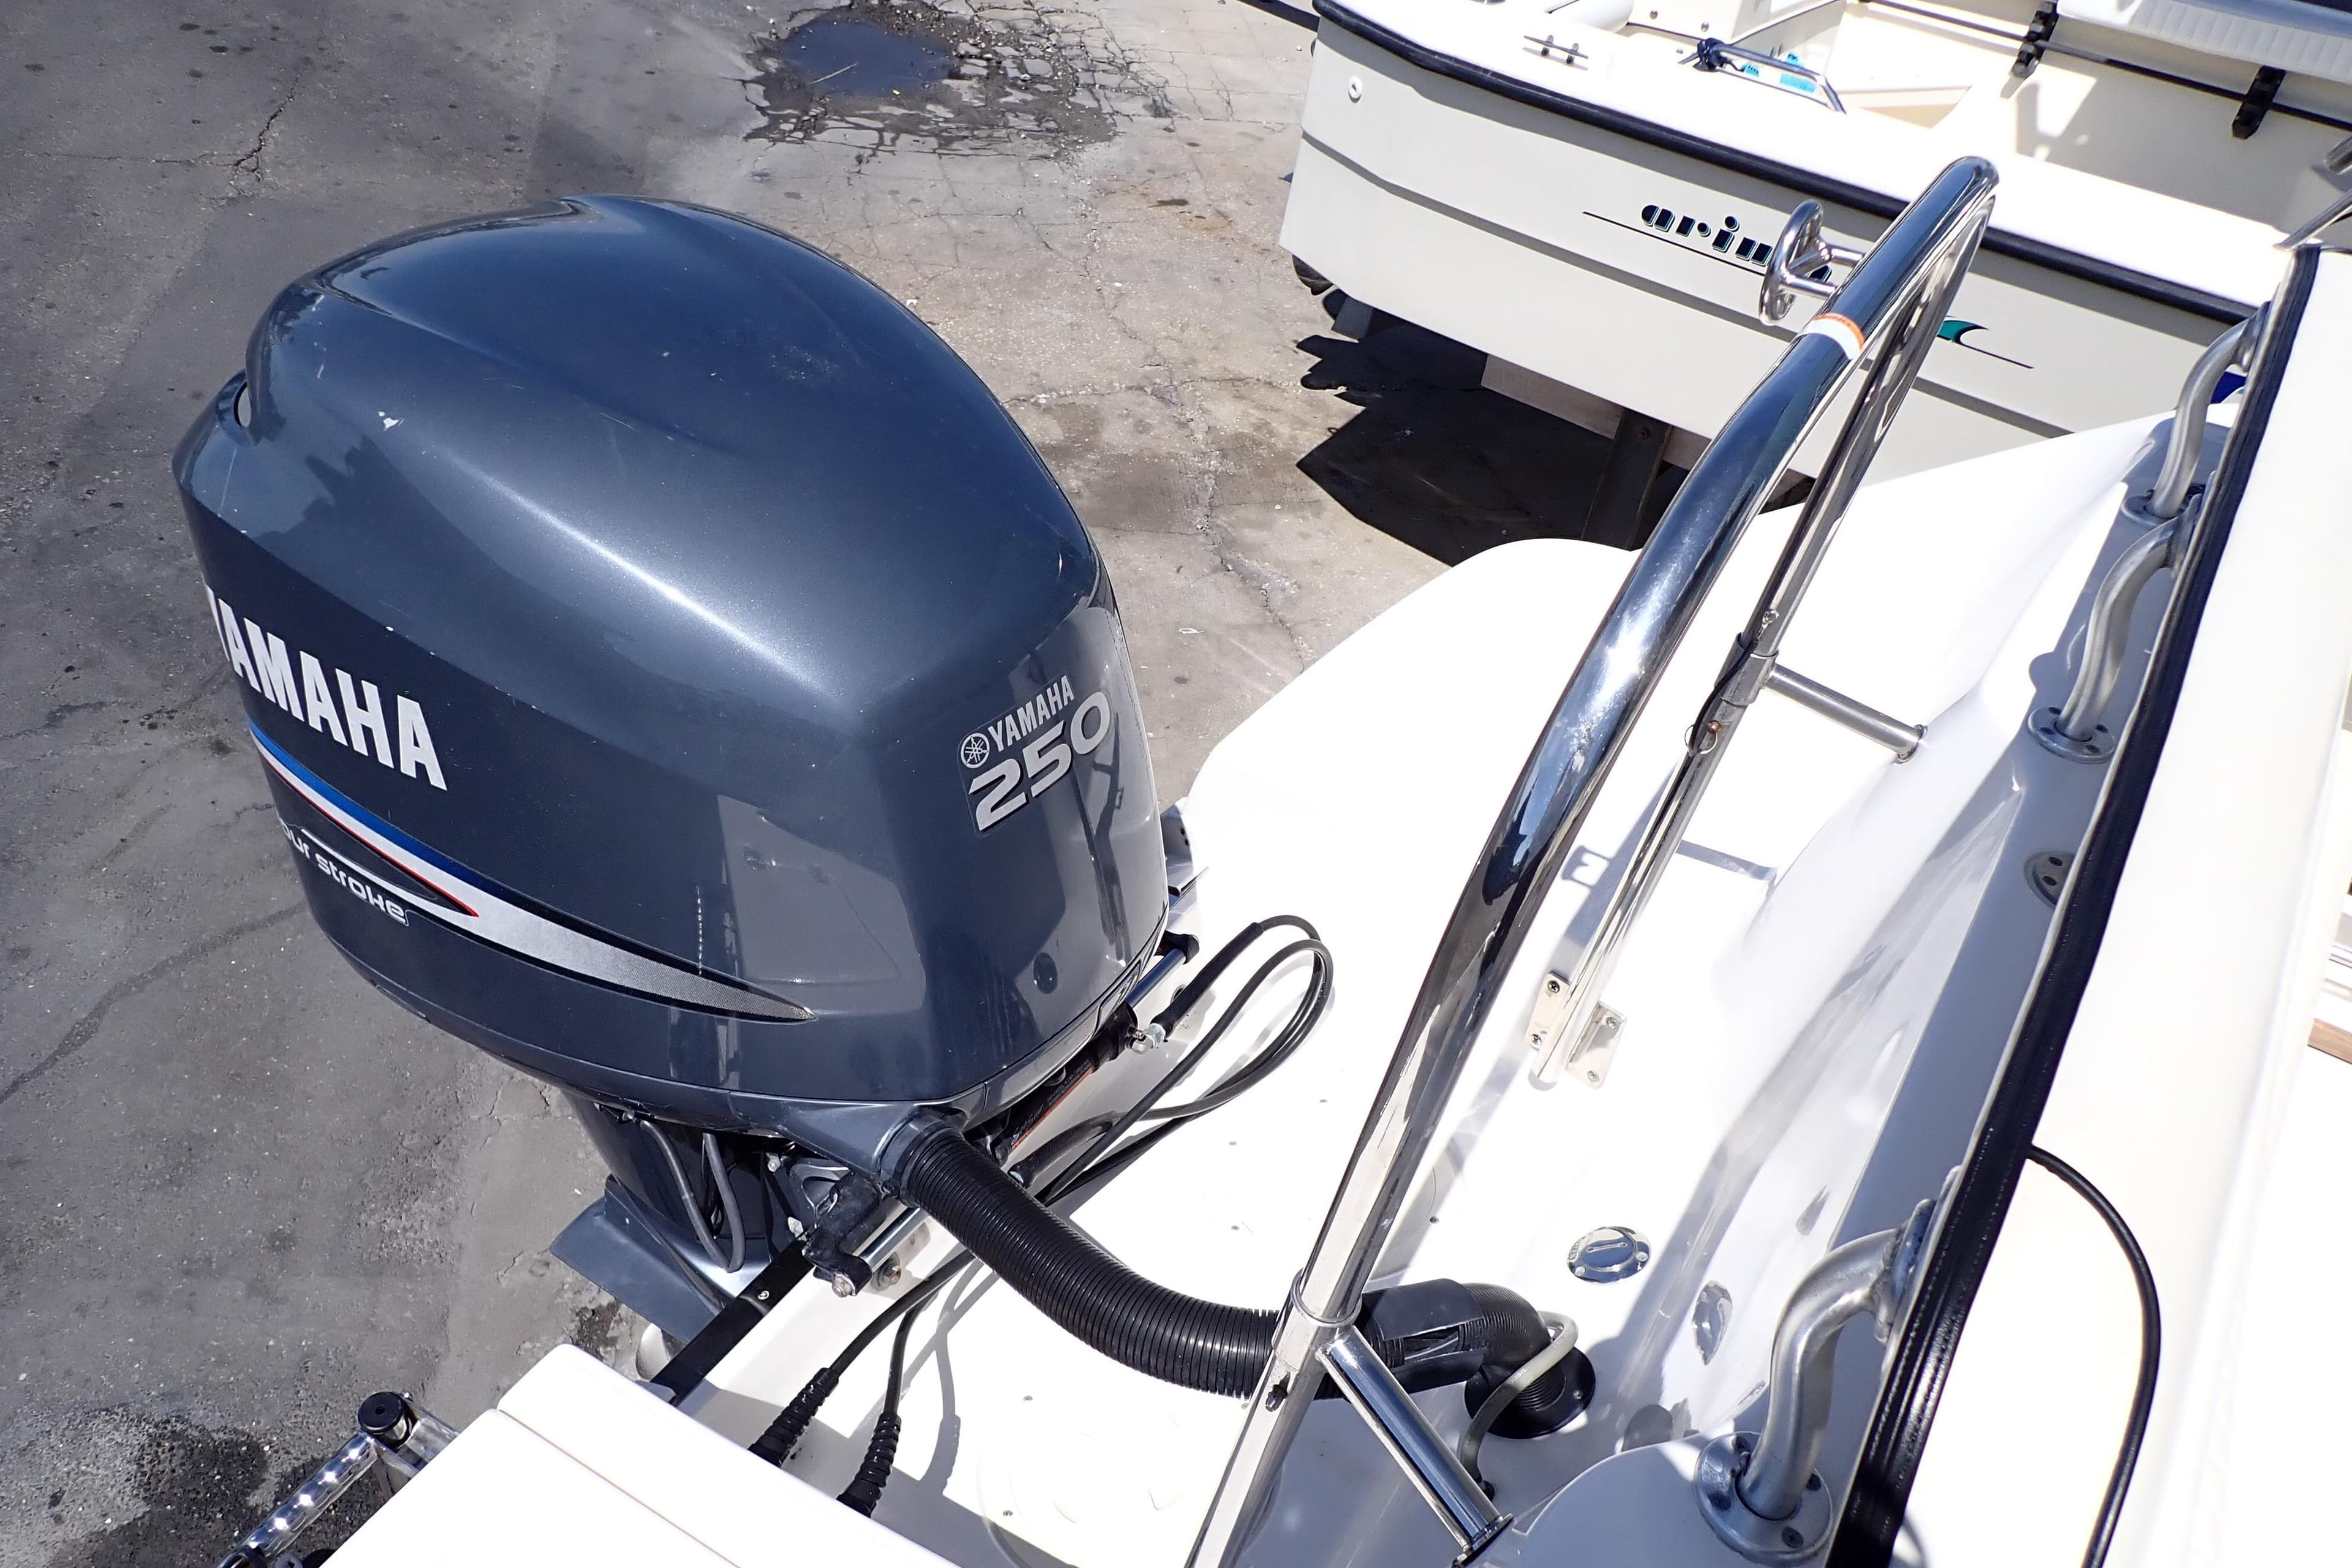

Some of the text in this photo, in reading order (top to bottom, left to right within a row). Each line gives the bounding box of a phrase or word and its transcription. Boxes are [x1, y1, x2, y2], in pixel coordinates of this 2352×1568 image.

[987, 674, 1075, 753] YAMAHA
[968, 691, 1111, 832] 250
[315, 853, 406, 924] stroke
